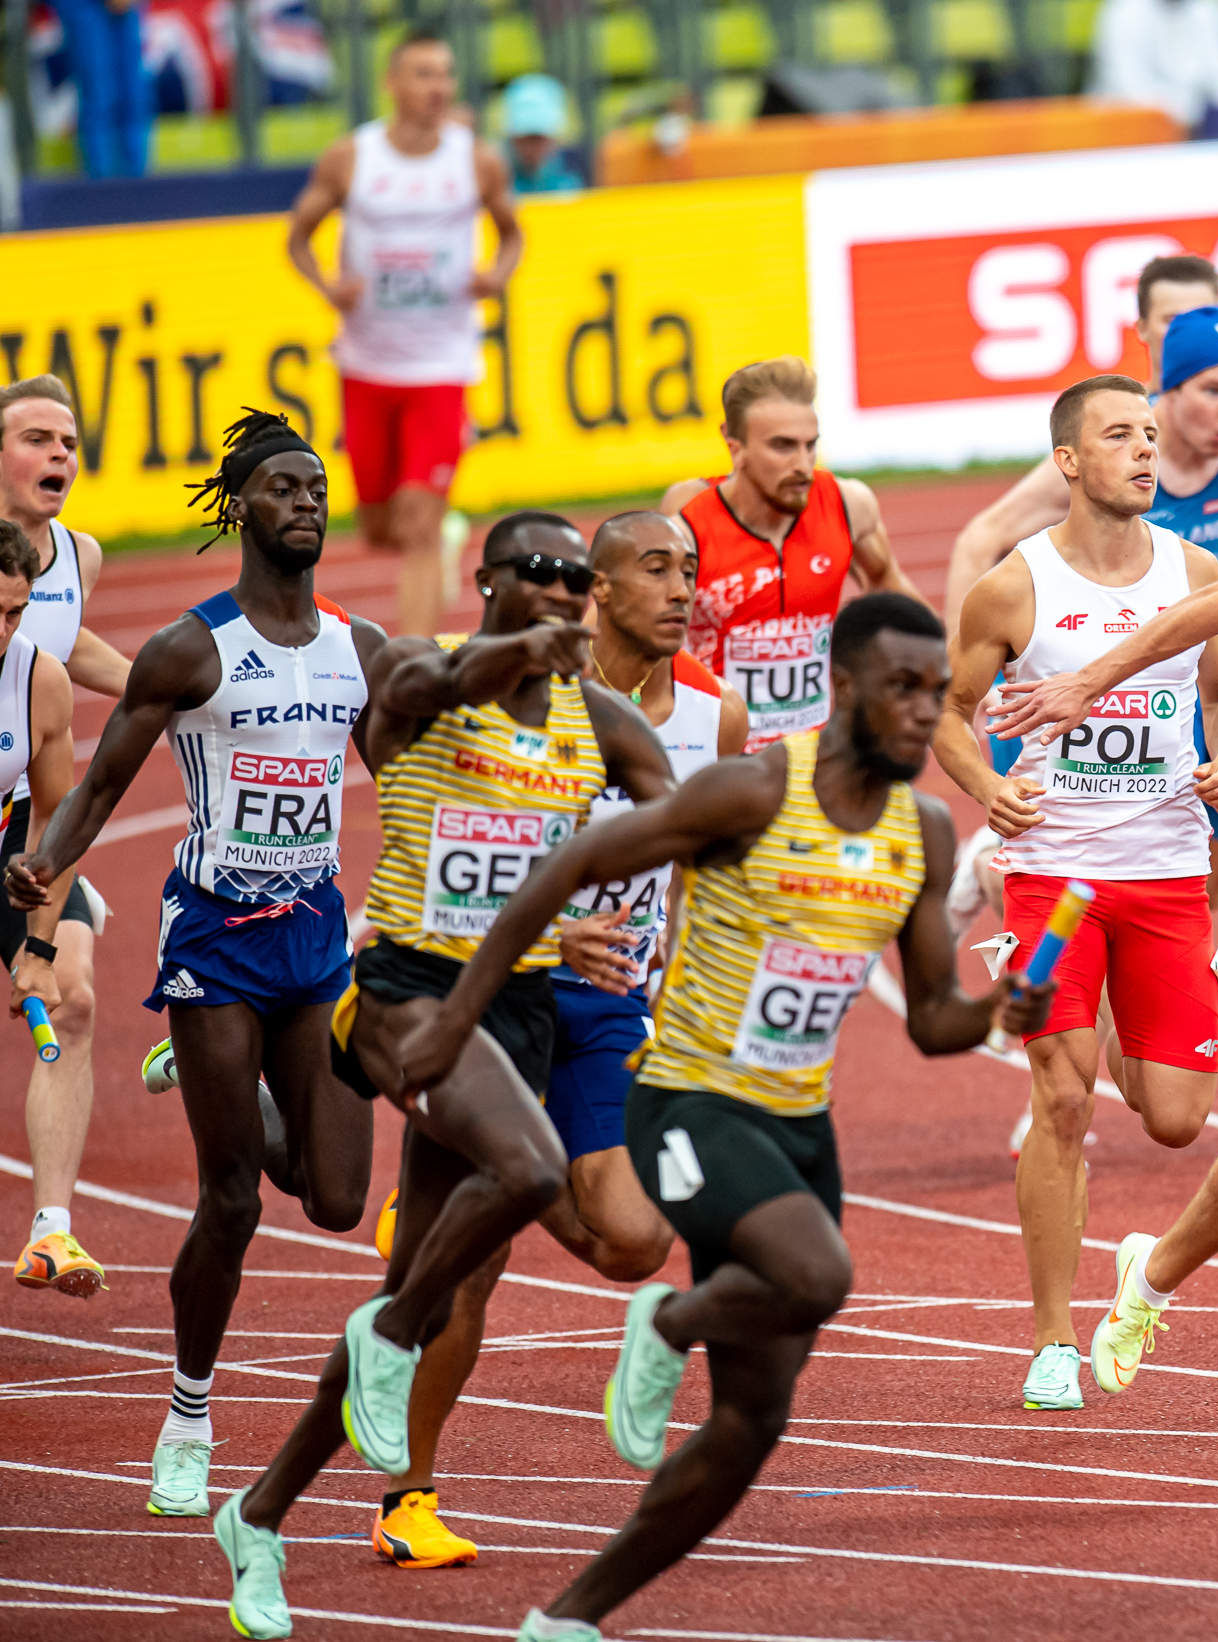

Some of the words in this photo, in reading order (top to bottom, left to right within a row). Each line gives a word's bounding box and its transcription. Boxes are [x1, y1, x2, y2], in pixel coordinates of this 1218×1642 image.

[0, 299, 223, 475] Wir
[564, 270, 705, 431] da
[29, 591, 63, 602] Allianz
[1055, 613, 1089, 631] 4F
[1105, 623, 1138, 632] ORLEN
[731, 636, 811, 659] SPAR
[230, 668, 275, 683] adidas
[736, 661, 823, 703] TUR
[1060, 723, 1166, 764] POL
[234, 756, 326, 784] SPAR
[455, 749, 584, 798] GERMANY
[1076, 763, 1081, 772] I
[1083, 763, 1108, 773] RUN
[1053, 773, 1121, 793] MUNICH
[1127, 778, 1167, 793] 2022
[234, 789, 332, 836] FRA
[440, 811, 541, 842] SPAR
[251, 834, 256, 844] I
[258, 835, 283, 846] RUN
[225, 846, 295, 866] MUNICH
[298, 847, 331, 864] 2022
[591, 876, 656, 914] RA
[433, 909, 493, 930] MUNIC
[767, 944, 863, 982] SPAR
[163, 984, 205, 999] adidas
